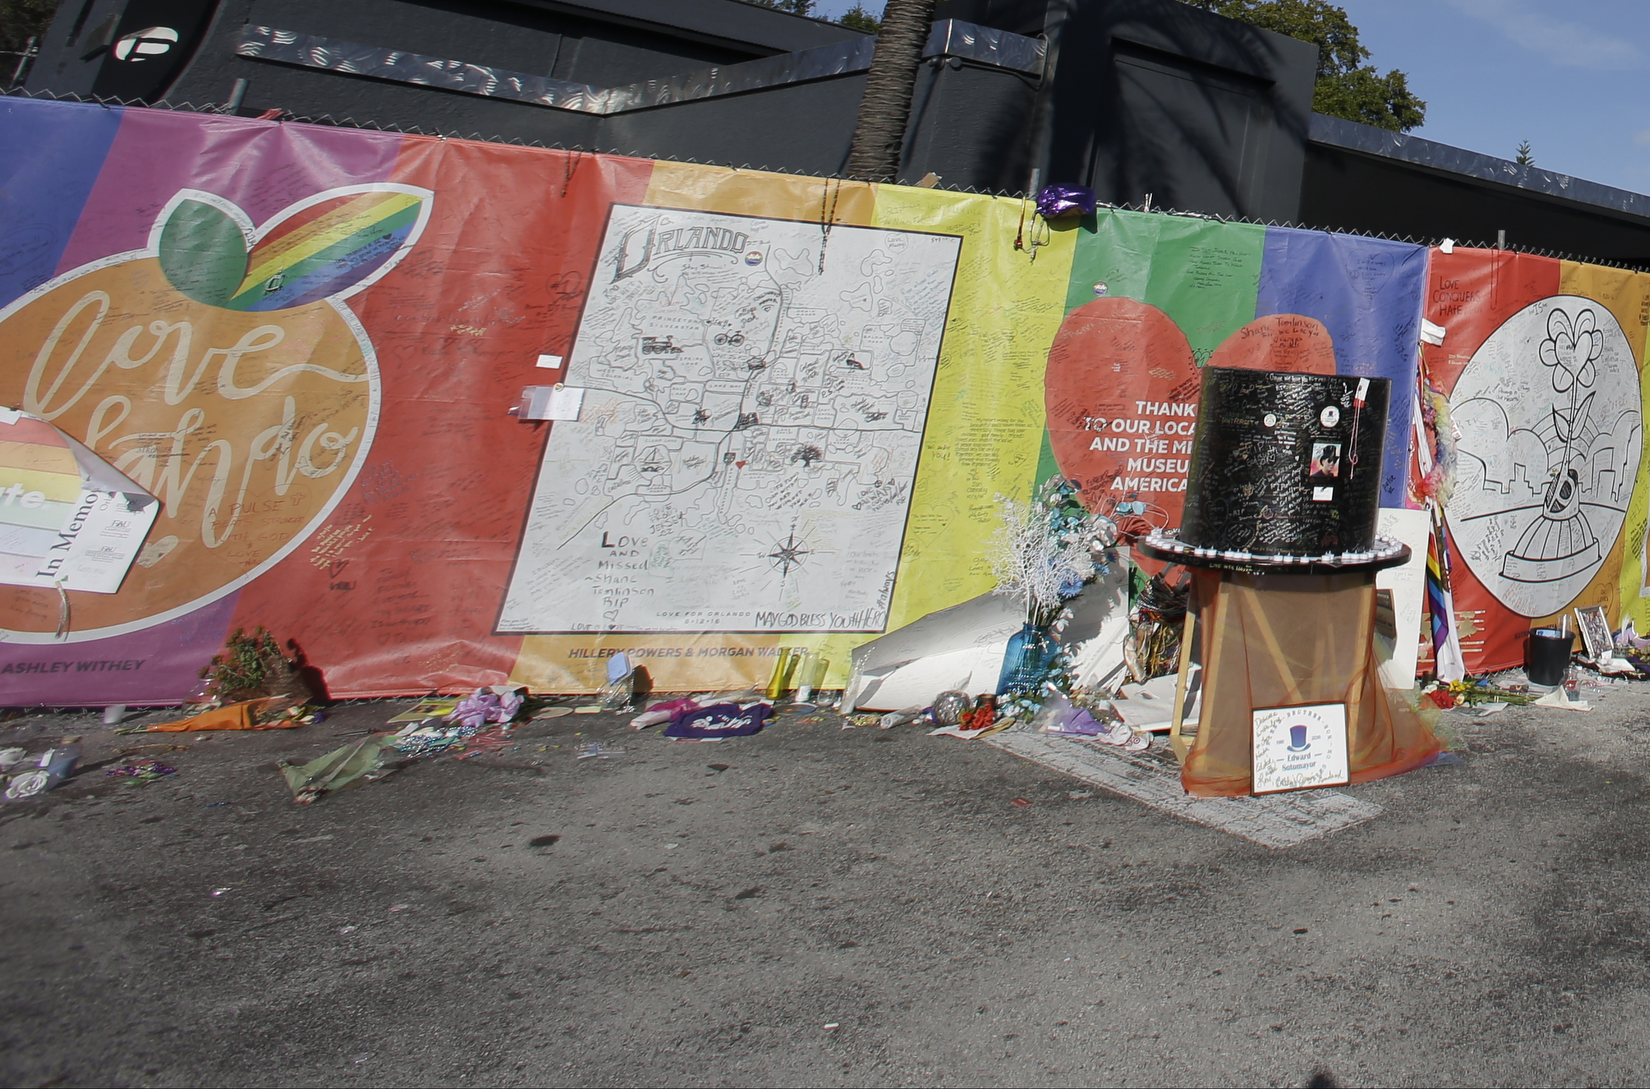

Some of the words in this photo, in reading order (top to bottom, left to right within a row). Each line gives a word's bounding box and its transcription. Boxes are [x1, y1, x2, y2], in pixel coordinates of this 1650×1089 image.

[610, 214, 749, 285] ORLANDO
[1439, 276, 1460, 290] LOVE
[1433, 290, 1481, 303] CONQUERS
[1439, 304, 1462, 316] HATE
[1275, 317, 1319, 330] Tomlinson
[23, 290, 371, 419] love
[1135, 401, 1197, 417] THANK
[1084, 416, 1108, 432] TO
[1111, 419, 1149, 433] OUR
[1154, 421, 1197, 435] LOCA
[1090, 437, 1131, 452] AND
[1134, 439, 1169, 454] THE
[1127, 458, 1190, 473] MUSEU
[1110, 477, 1188, 492] AMERICA
[50, 492, 99, 552] Memo
[598, 560, 649, 571] Missed
[603, 597, 630, 608] RIP
[800, 612, 827, 627] BLESS
[568, 648, 625, 658] HILLERY
[627, 648, 682, 658] POWERS
[685, 648, 693, 657] &
[698, 647, 755, 657] MORGAN
[1, 661, 74, 674] ASHLEY
[76, 659, 145, 672] WITHEY
[1287, 753, 1311, 762] Edward
[1281, 761, 1316, 771] Sotomayor
